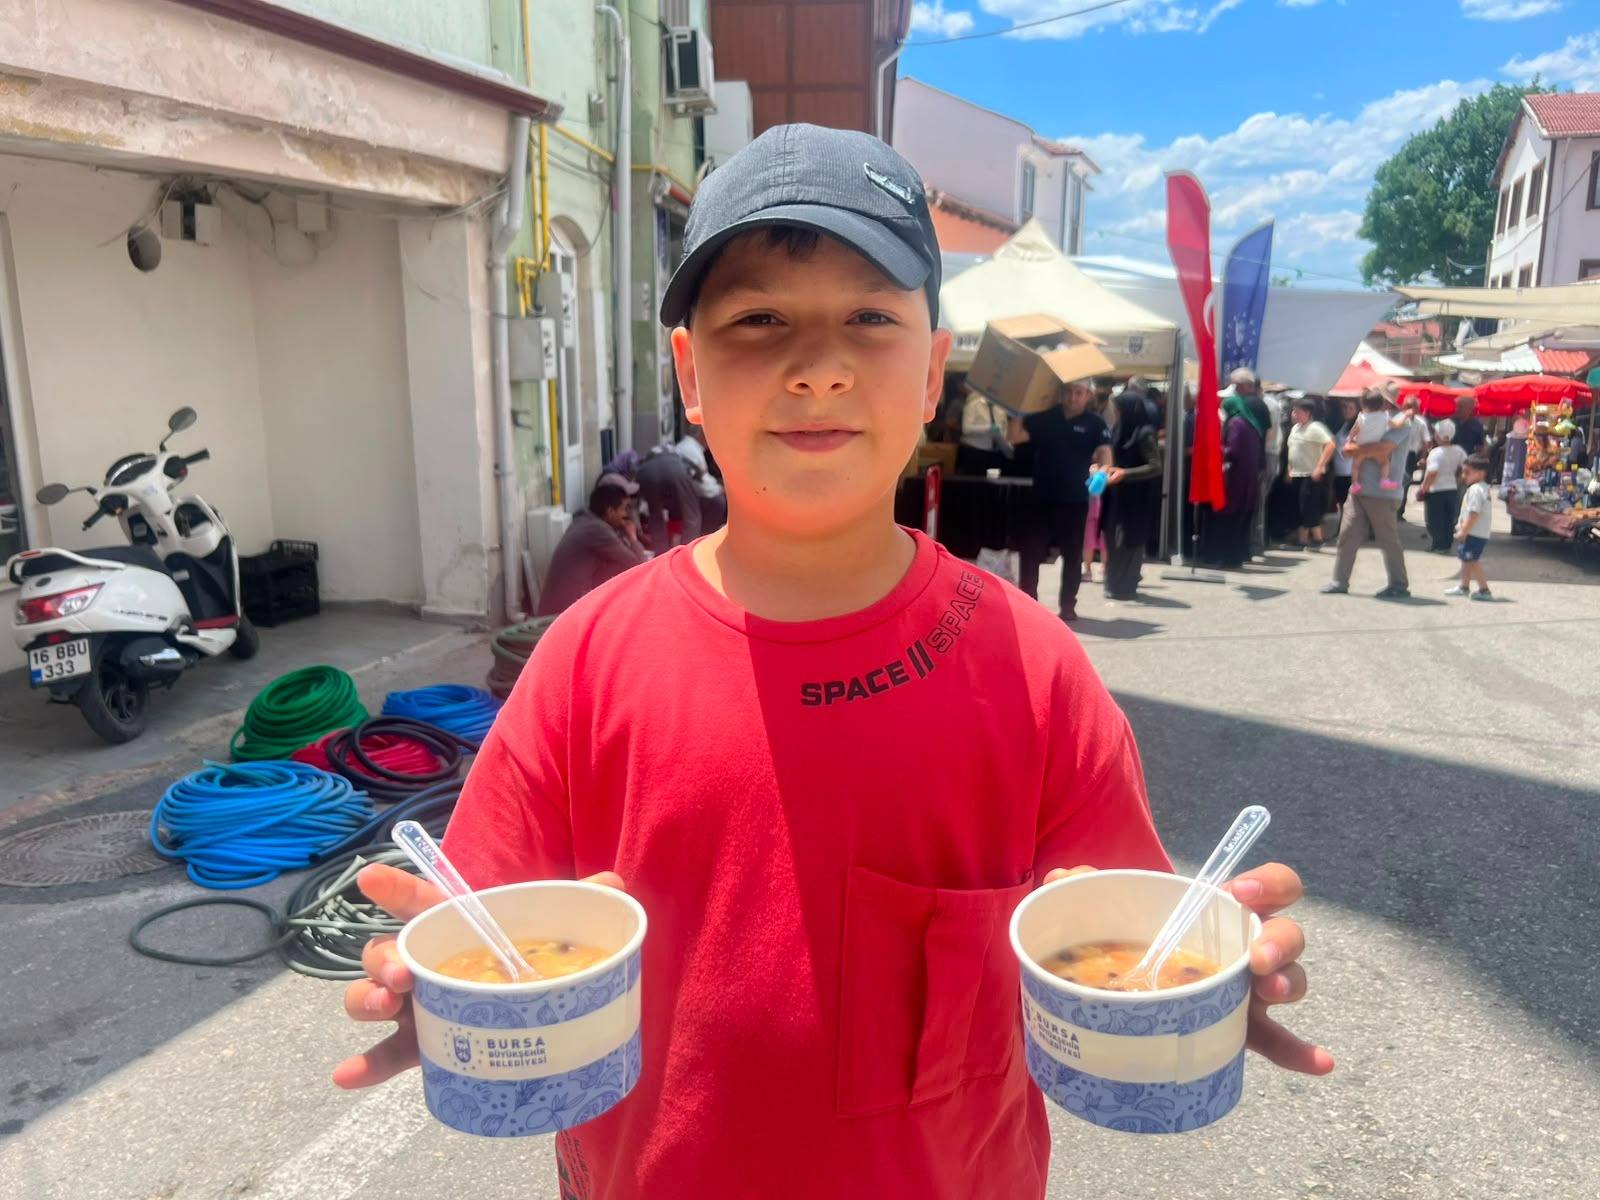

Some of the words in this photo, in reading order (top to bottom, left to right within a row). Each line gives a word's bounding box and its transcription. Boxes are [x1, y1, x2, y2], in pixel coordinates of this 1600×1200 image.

[801, 660, 910, 706] SPACE
[925, 571, 984, 653] SPACE
[33, 649, 50, 665] 16
[56, 641, 87, 660] BBU
[45, 660, 75, 678] 333
[1036, 1011, 1079, 1043] BURSA
[487, 1036, 546, 1049] BURSA
[488, 1047, 546, 1058] BÜYÜKŞEHİR
[489, 1053, 547, 1067] BELEDİYESİ
